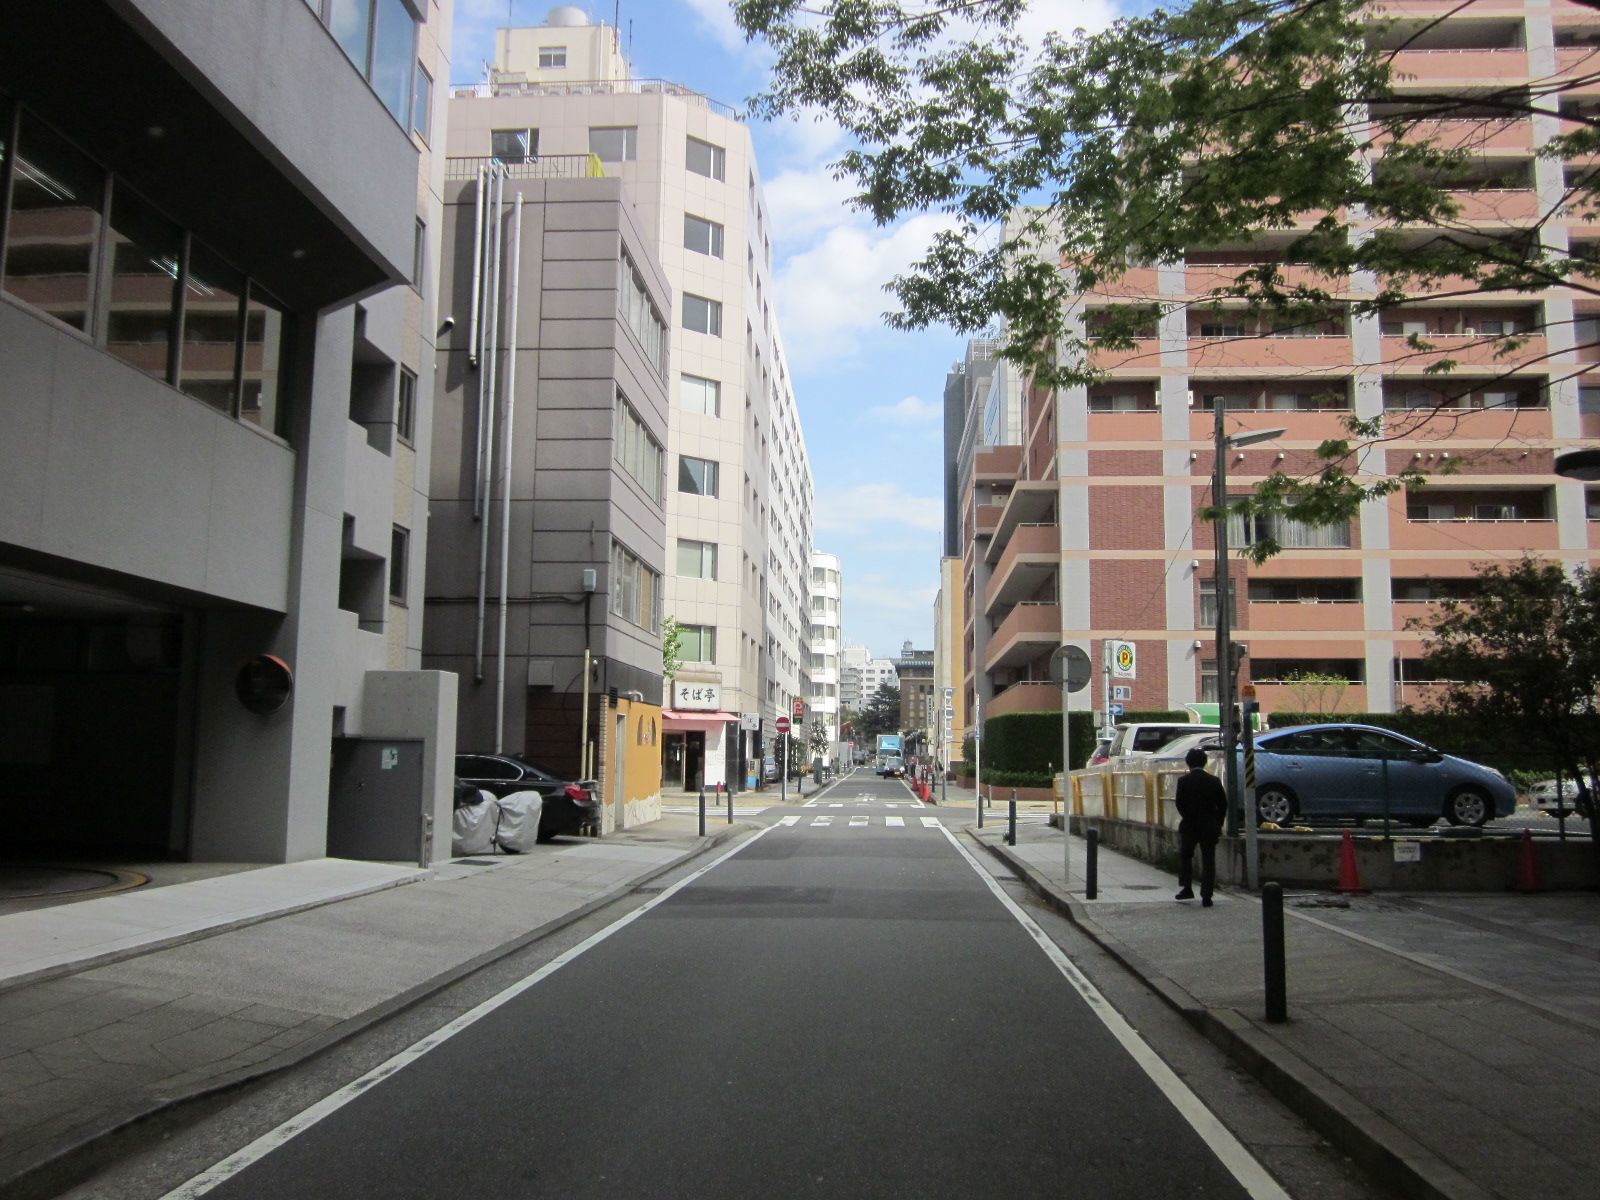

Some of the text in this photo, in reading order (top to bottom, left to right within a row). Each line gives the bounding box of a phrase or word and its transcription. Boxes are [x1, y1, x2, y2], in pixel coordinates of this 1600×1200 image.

[1122, 651, 1128, 663] P
[680, 688, 715, 702] そば亭
[1116, 688, 1121, 698] P
